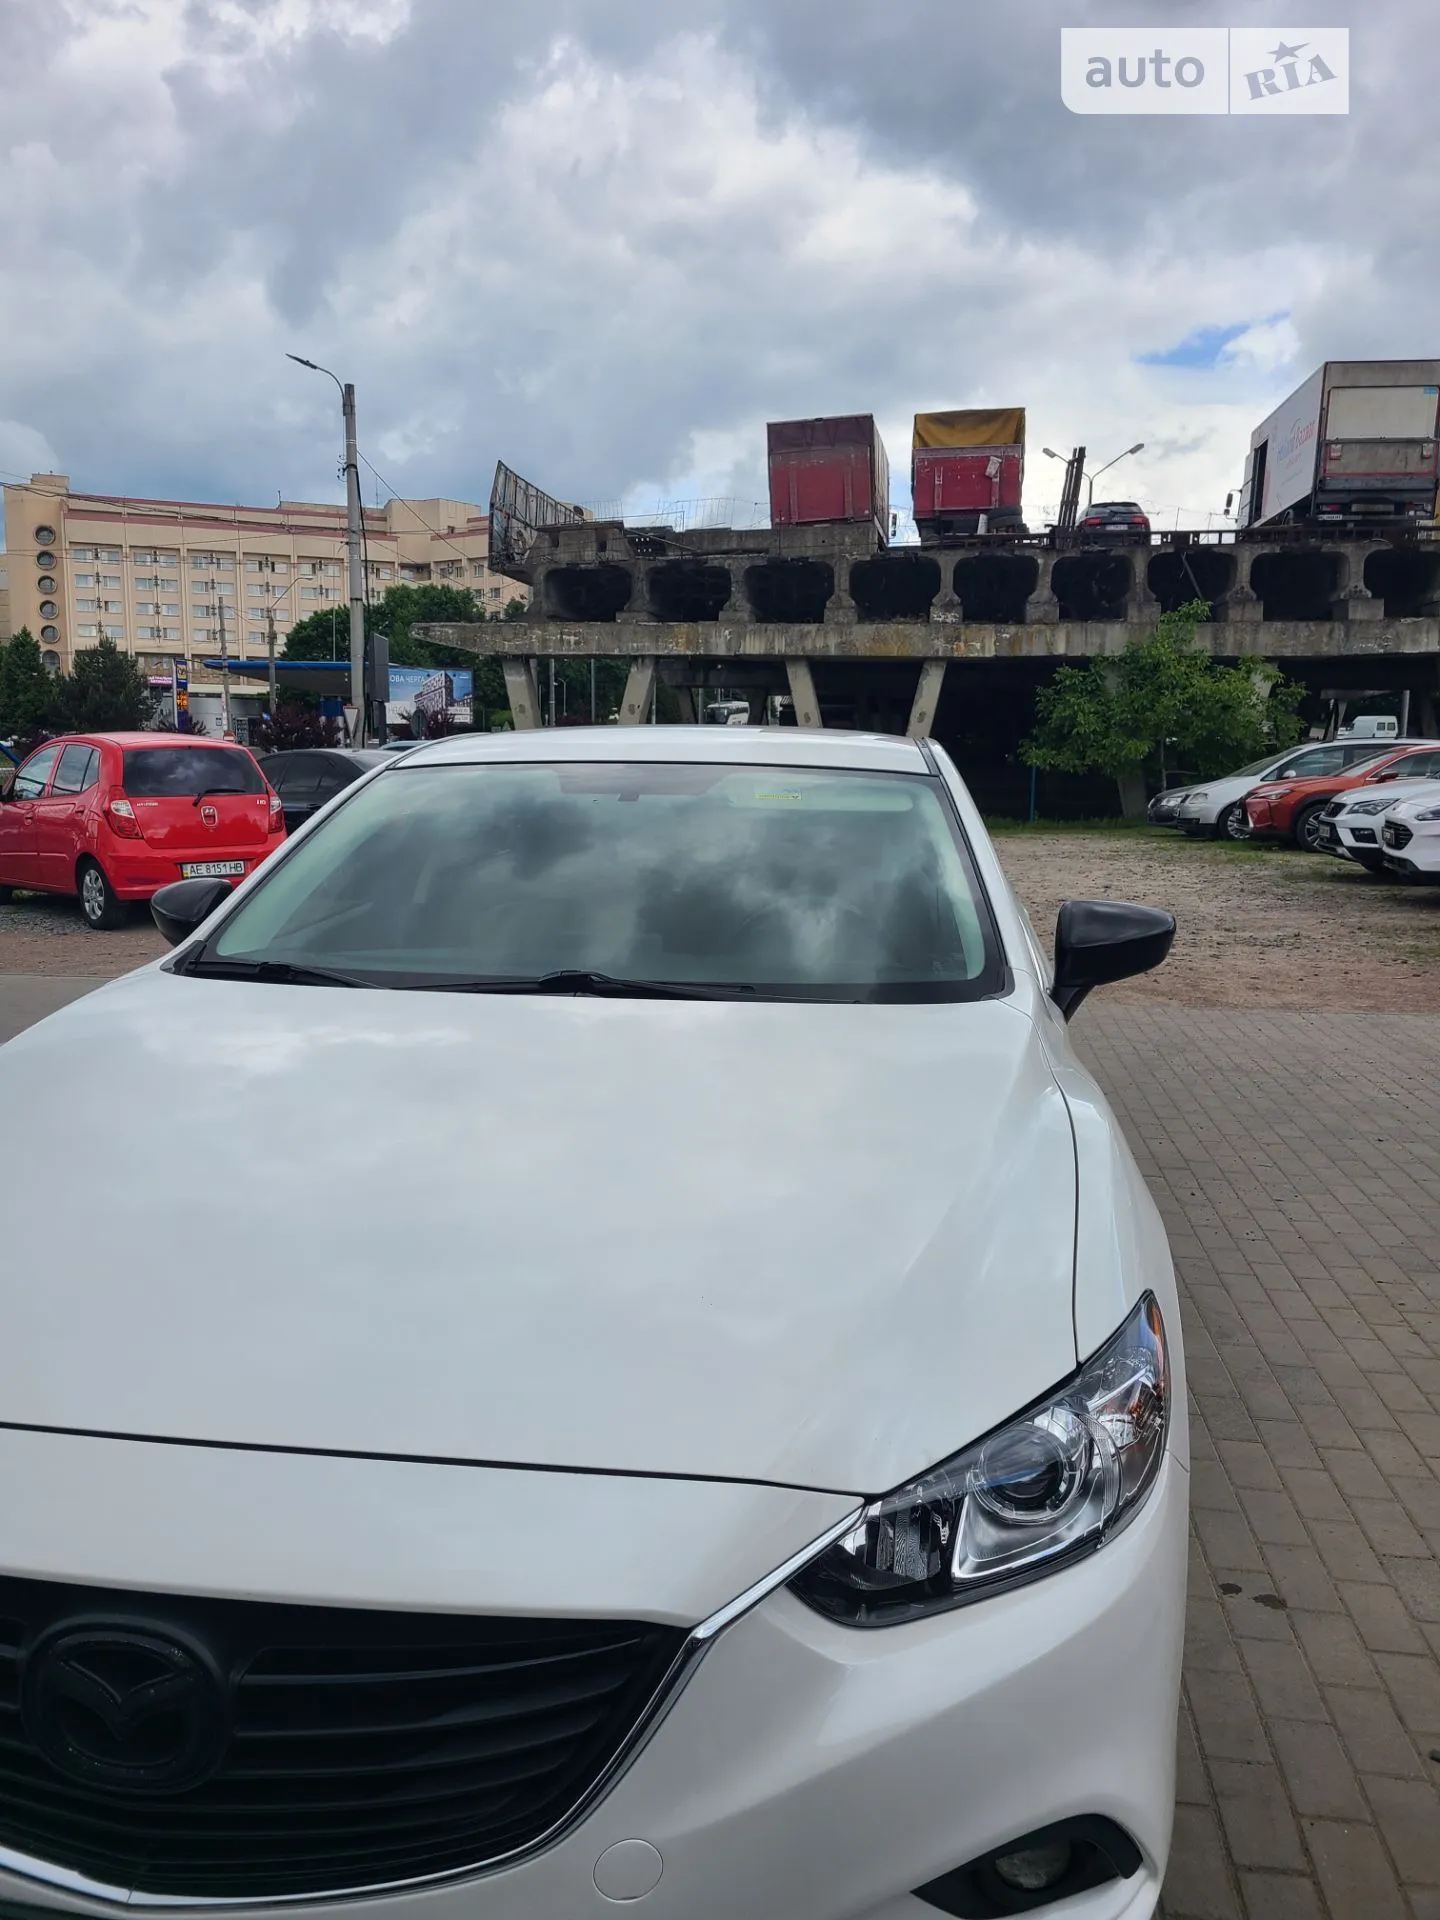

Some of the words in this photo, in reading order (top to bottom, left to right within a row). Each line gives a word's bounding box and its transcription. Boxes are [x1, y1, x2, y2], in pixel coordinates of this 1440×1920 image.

[390, 674, 405, 682] ОВА
[190, 864, 203, 875] AE
[205, 863, 228, 874] 8151
[229, 862, 243, 873] HB
